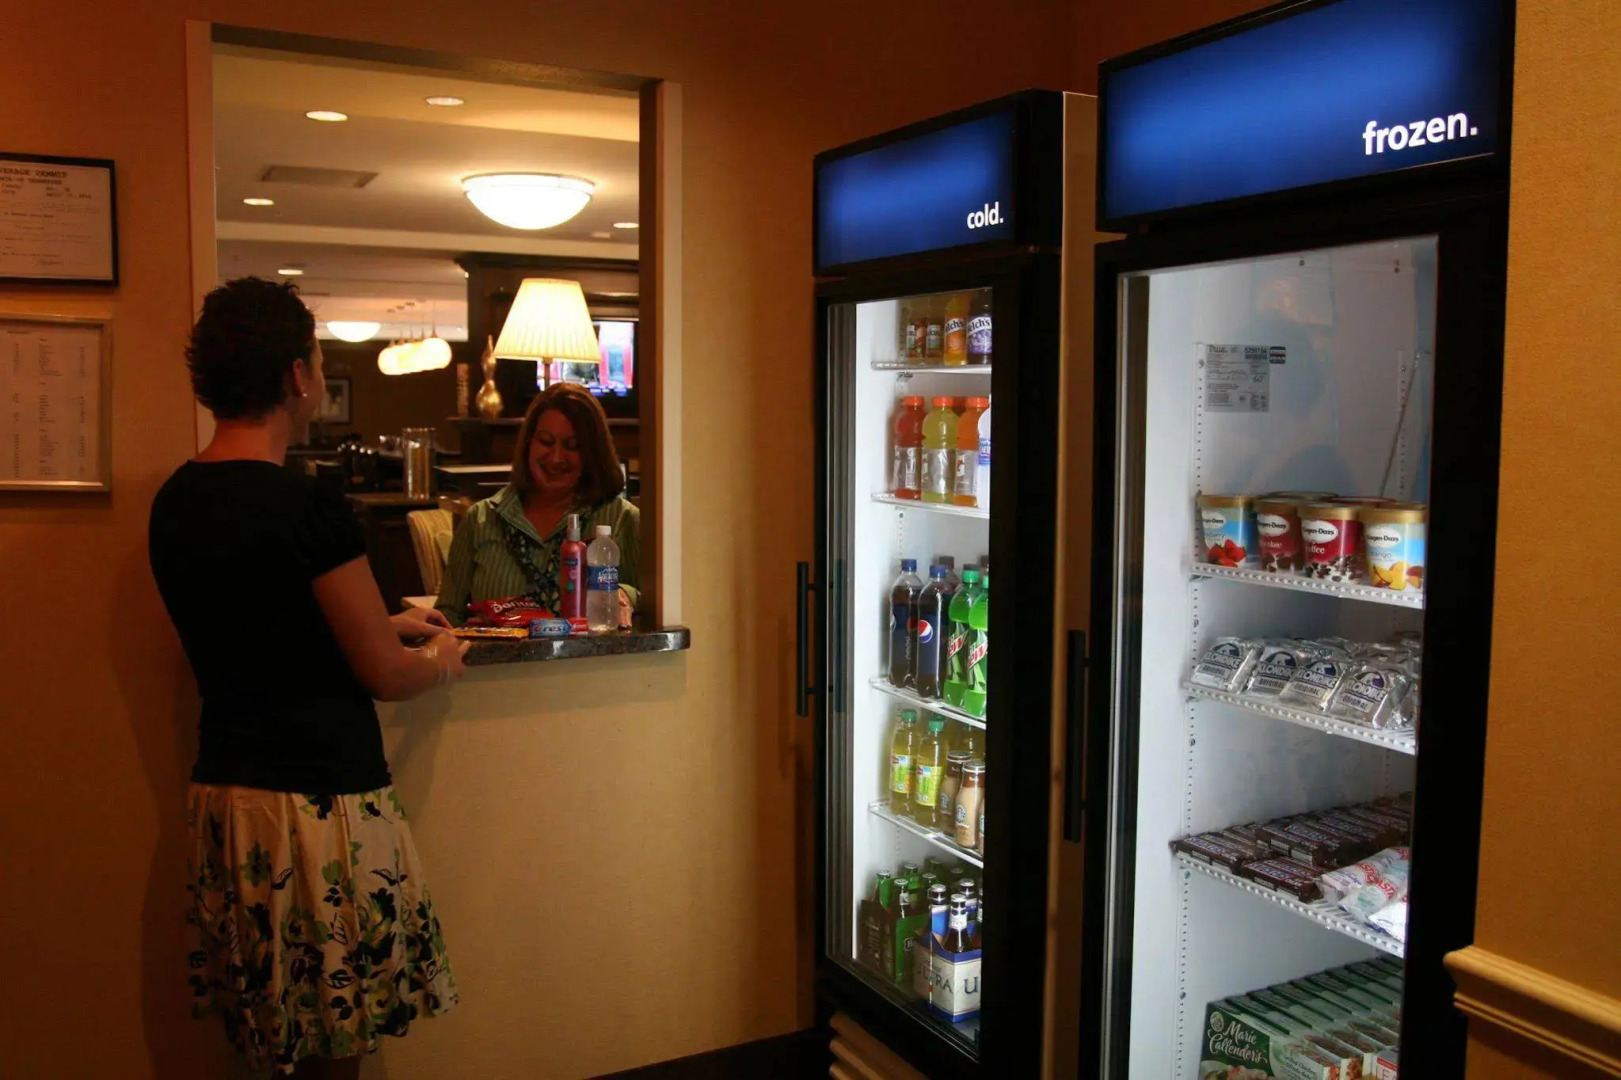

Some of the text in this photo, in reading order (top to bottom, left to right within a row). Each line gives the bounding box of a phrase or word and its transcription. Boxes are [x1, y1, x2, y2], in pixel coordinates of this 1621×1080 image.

[1362, 110, 1478, 156] frozen.
[967, 201, 1004, 230] cold.
[533, 622, 566, 634] Crest
[1203, 651, 1242, 669] KLONDIKE
[1207, 1028, 1269, 1065] Callender's
[1223, 1020, 1258, 1046] Marie
